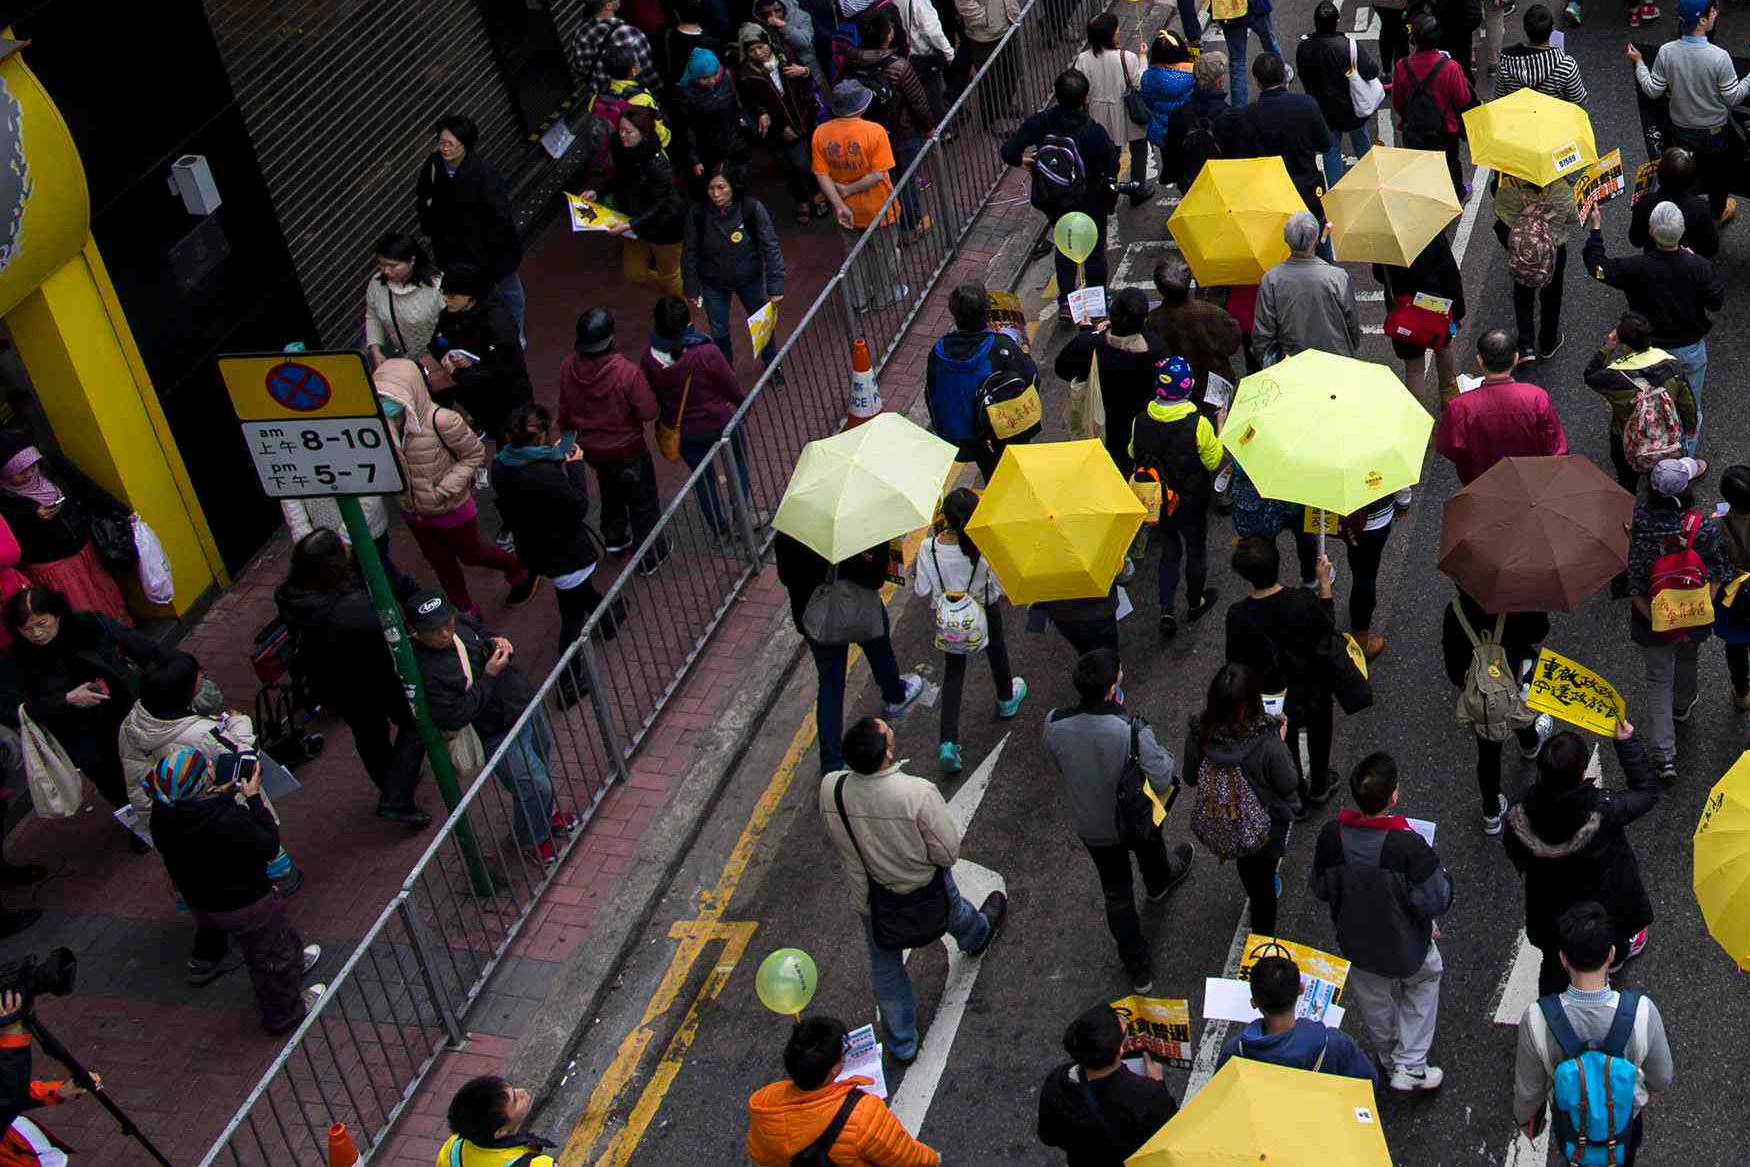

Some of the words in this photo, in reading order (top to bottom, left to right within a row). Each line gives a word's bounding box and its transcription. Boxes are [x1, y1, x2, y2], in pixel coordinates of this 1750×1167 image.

[259, 428, 284, 438] am
[301, 428, 381, 451] 8-10
[259, 441, 298, 455] 上午
[271, 463, 297, 473] pm
[268, 475, 310, 490] 下午
